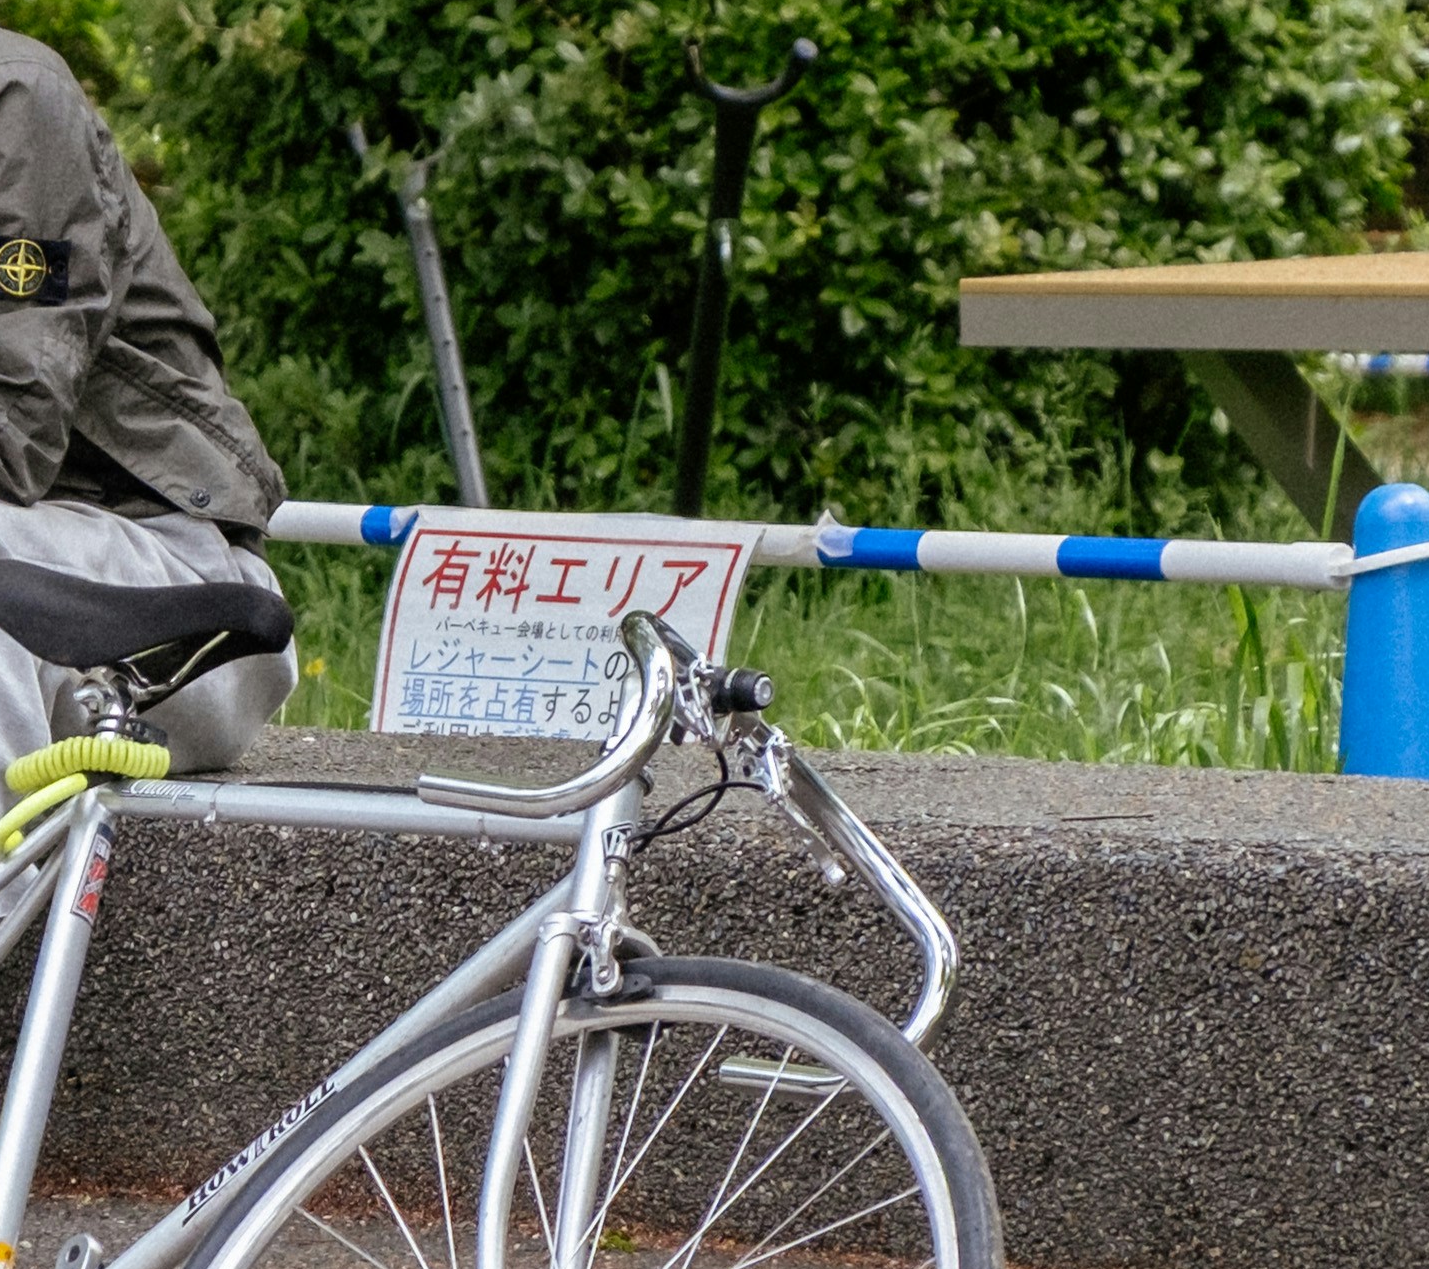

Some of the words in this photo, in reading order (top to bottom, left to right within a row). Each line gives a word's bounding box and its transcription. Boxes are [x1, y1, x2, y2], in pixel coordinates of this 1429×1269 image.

[422, 540, 712, 619] 有料エリア
[410, 640, 630, 683] レジャーシートの
